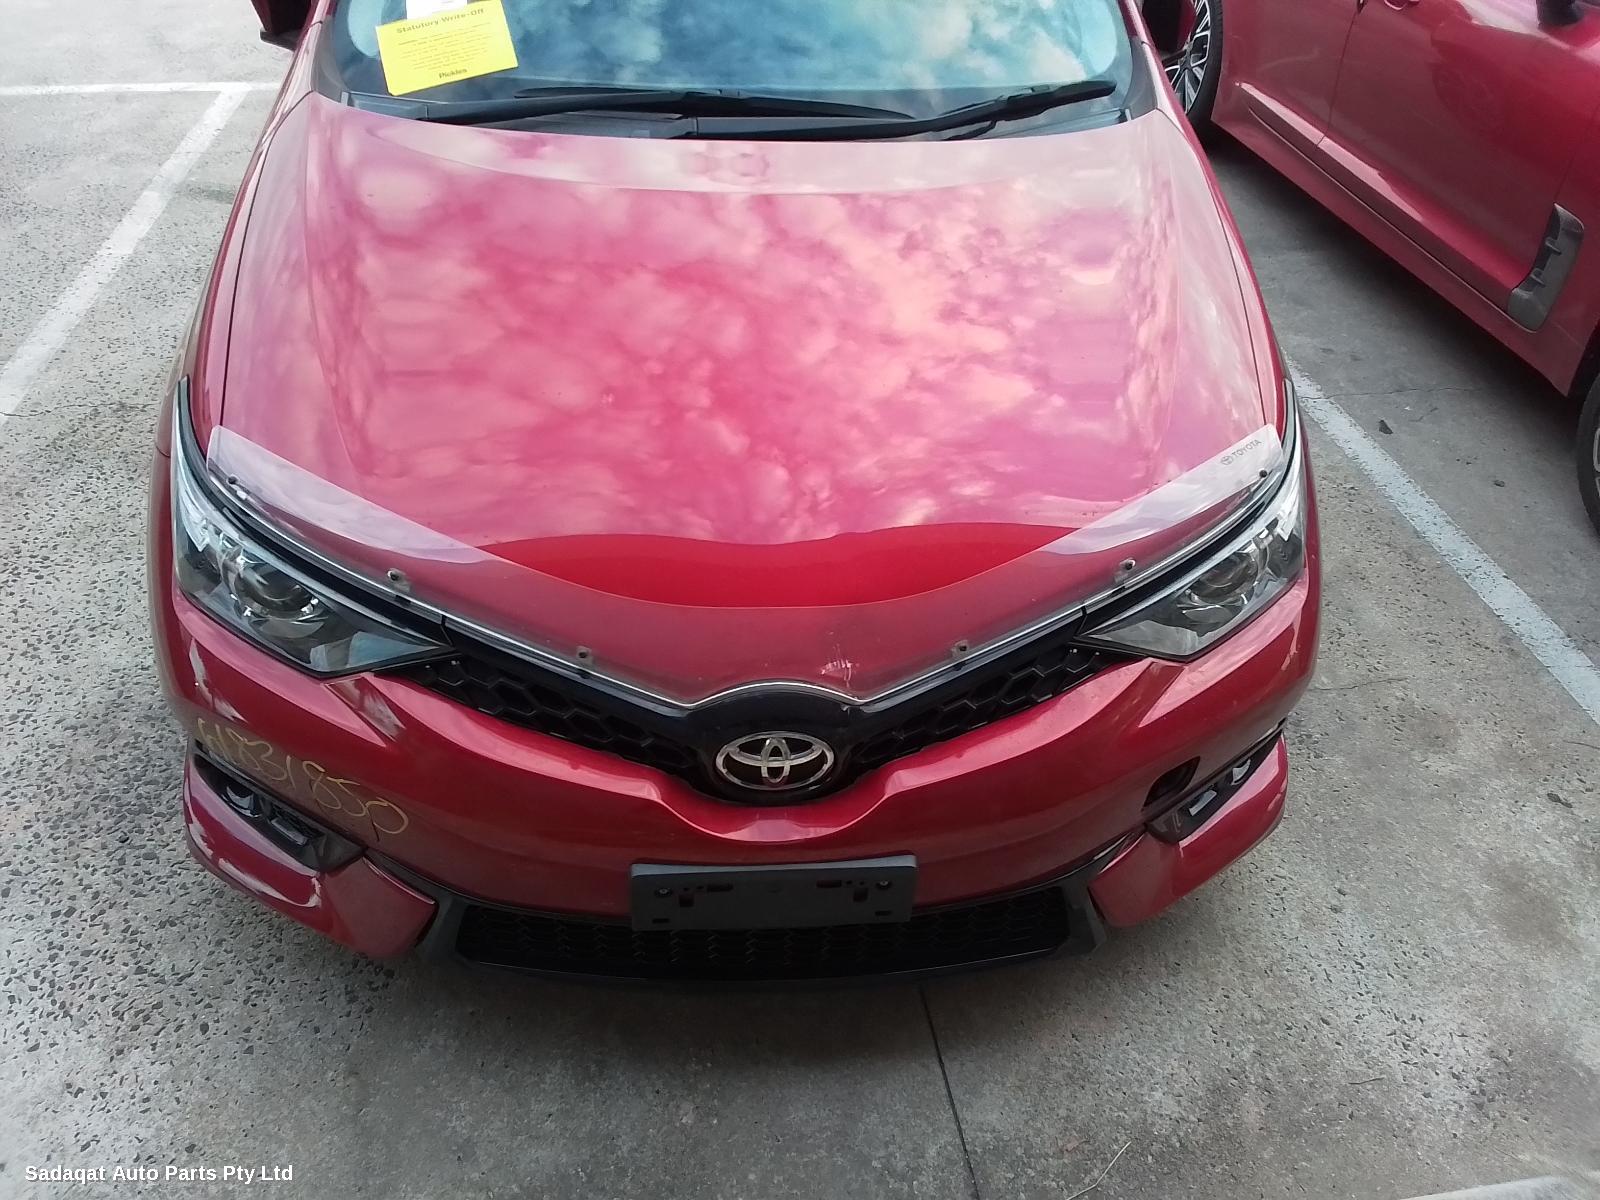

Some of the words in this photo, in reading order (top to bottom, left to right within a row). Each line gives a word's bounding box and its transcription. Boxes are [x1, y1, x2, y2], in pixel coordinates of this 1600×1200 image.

[396, 18, 439, 34] Statutory
[441, 7, 485, 24] Write-Off
[1231, 439, 1262, 458] TOYOTA
